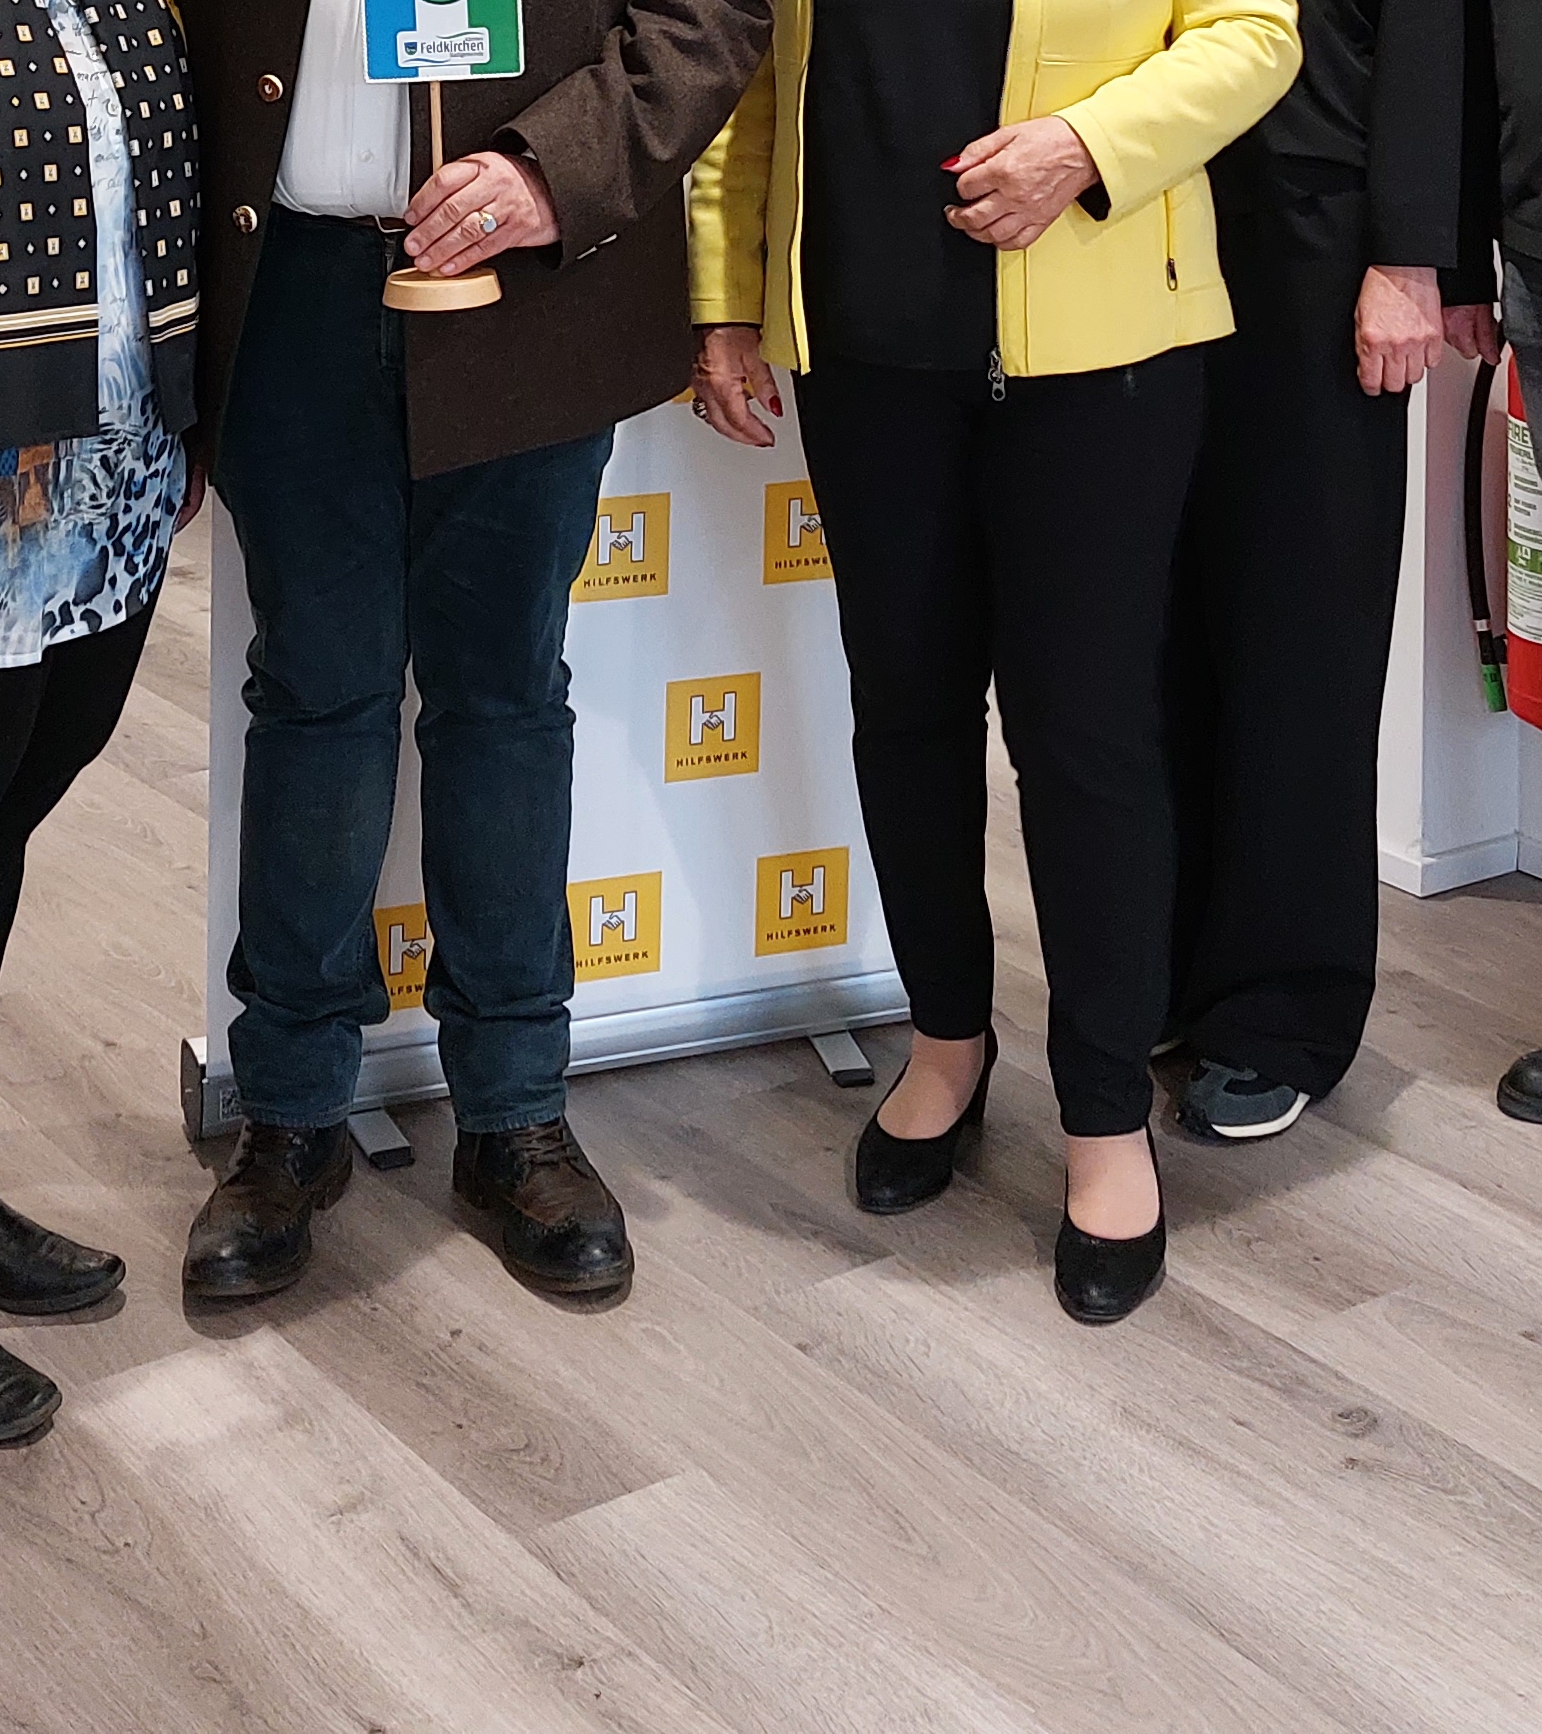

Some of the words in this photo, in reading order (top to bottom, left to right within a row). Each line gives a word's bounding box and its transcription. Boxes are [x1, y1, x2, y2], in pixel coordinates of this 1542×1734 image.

[420, 40, 484, 54] Feldkirchen
[774, 556, 828, 570] HILFSWE
[583, 572, 657, 589] HILFSWERK
[675, 750, 749, 769] HILFSWERK
[766, 922, 837, 942] HILFSWERK
[575, 950, 649, 969] HILFSWERK
